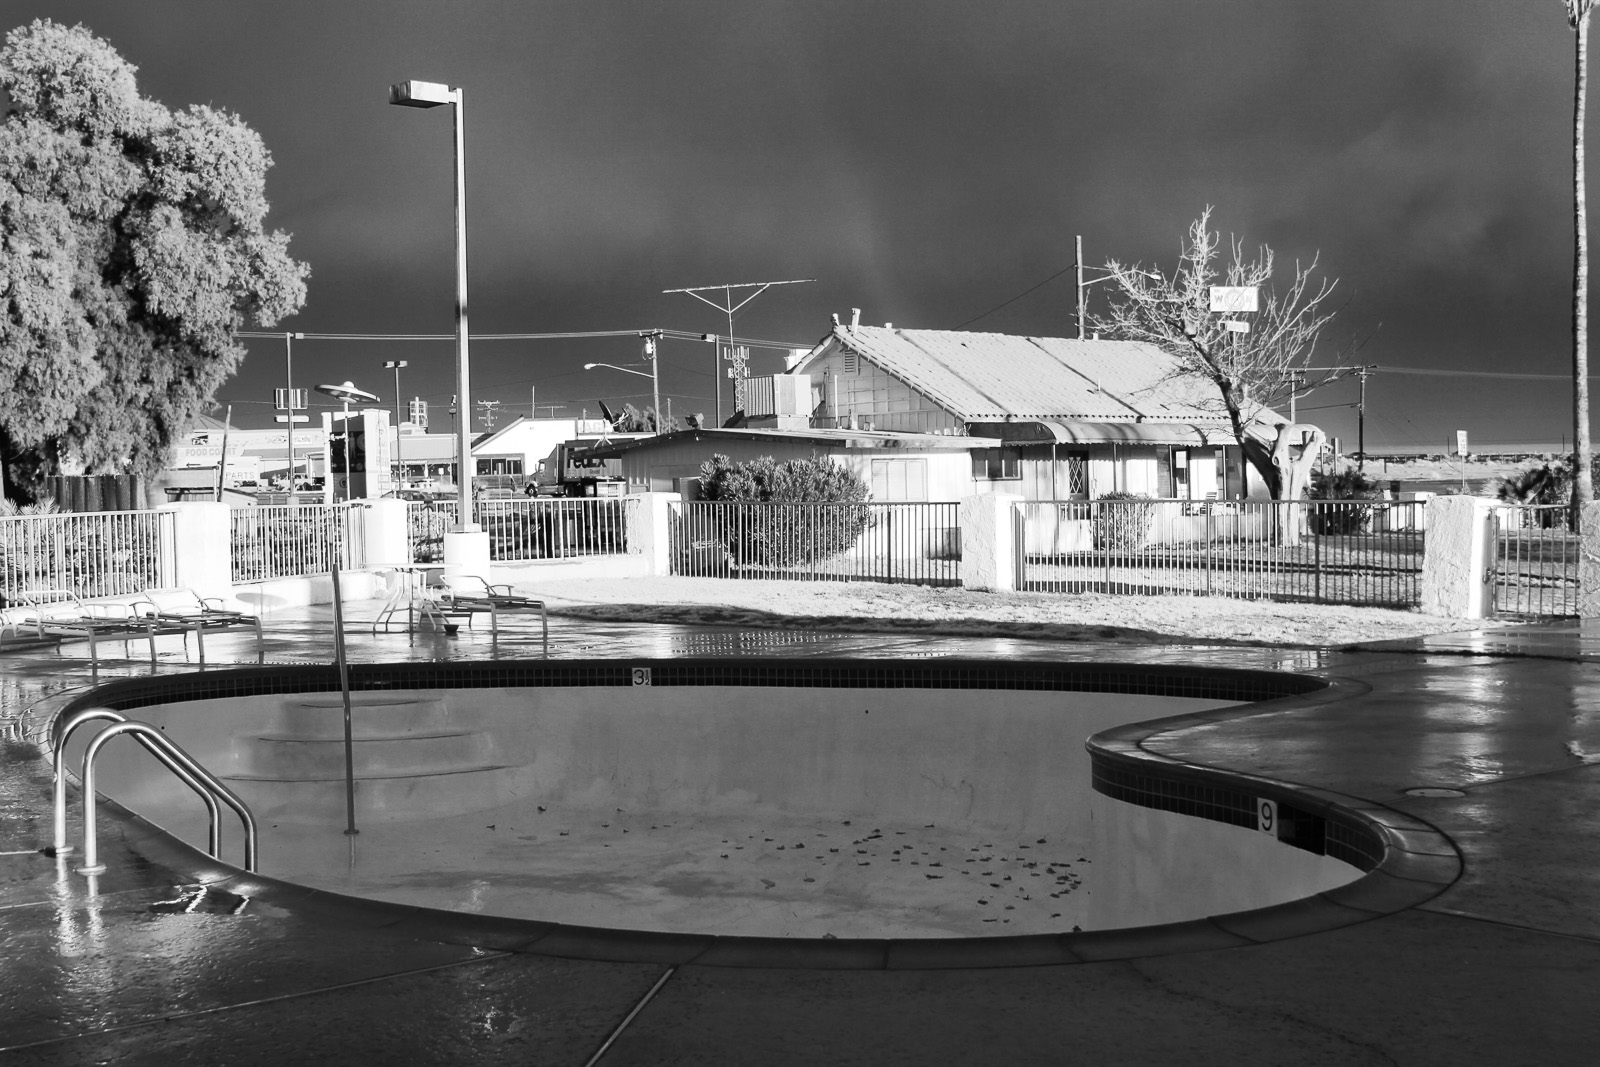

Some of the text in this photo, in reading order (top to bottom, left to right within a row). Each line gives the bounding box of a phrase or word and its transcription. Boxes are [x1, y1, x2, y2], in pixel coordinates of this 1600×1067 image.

[185, 447, 237, 457] FOOD CORT
[225, 471, 255, 480] PARTS
[1261, 802, 1273, 832] 9
